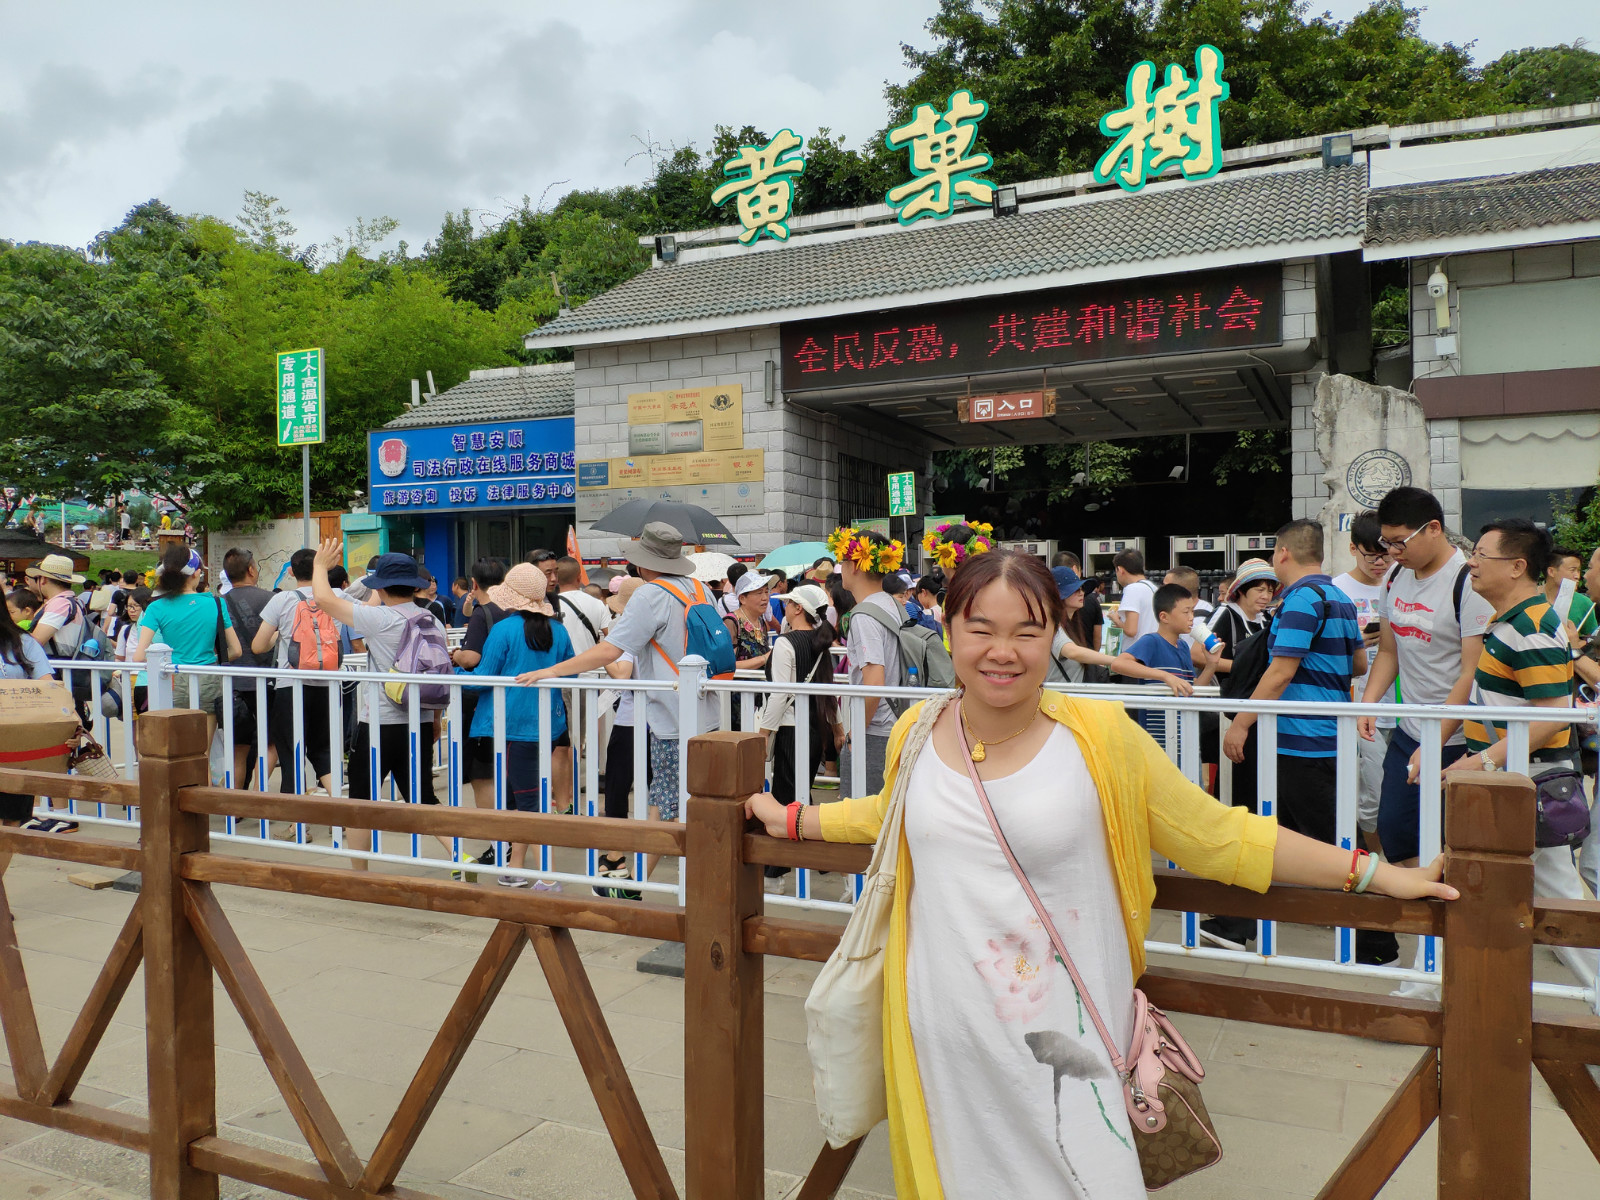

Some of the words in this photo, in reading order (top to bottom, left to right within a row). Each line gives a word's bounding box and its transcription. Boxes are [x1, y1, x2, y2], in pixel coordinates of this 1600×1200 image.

[281, 356, 297, 419] 专用通道
[301, 352, 318, 424] 十个高温省市
[998, 399, 1032, 411] 入口
[452, 429, 524, 452] 智慧安顺
[412, 451, 575, 477] 司法行政在线服务商城
[383, 487, 438, 505] 旅游咨询
[449, 486, 478, 502] 投诉
[487, 482, 575, 501] 法律服务中心
